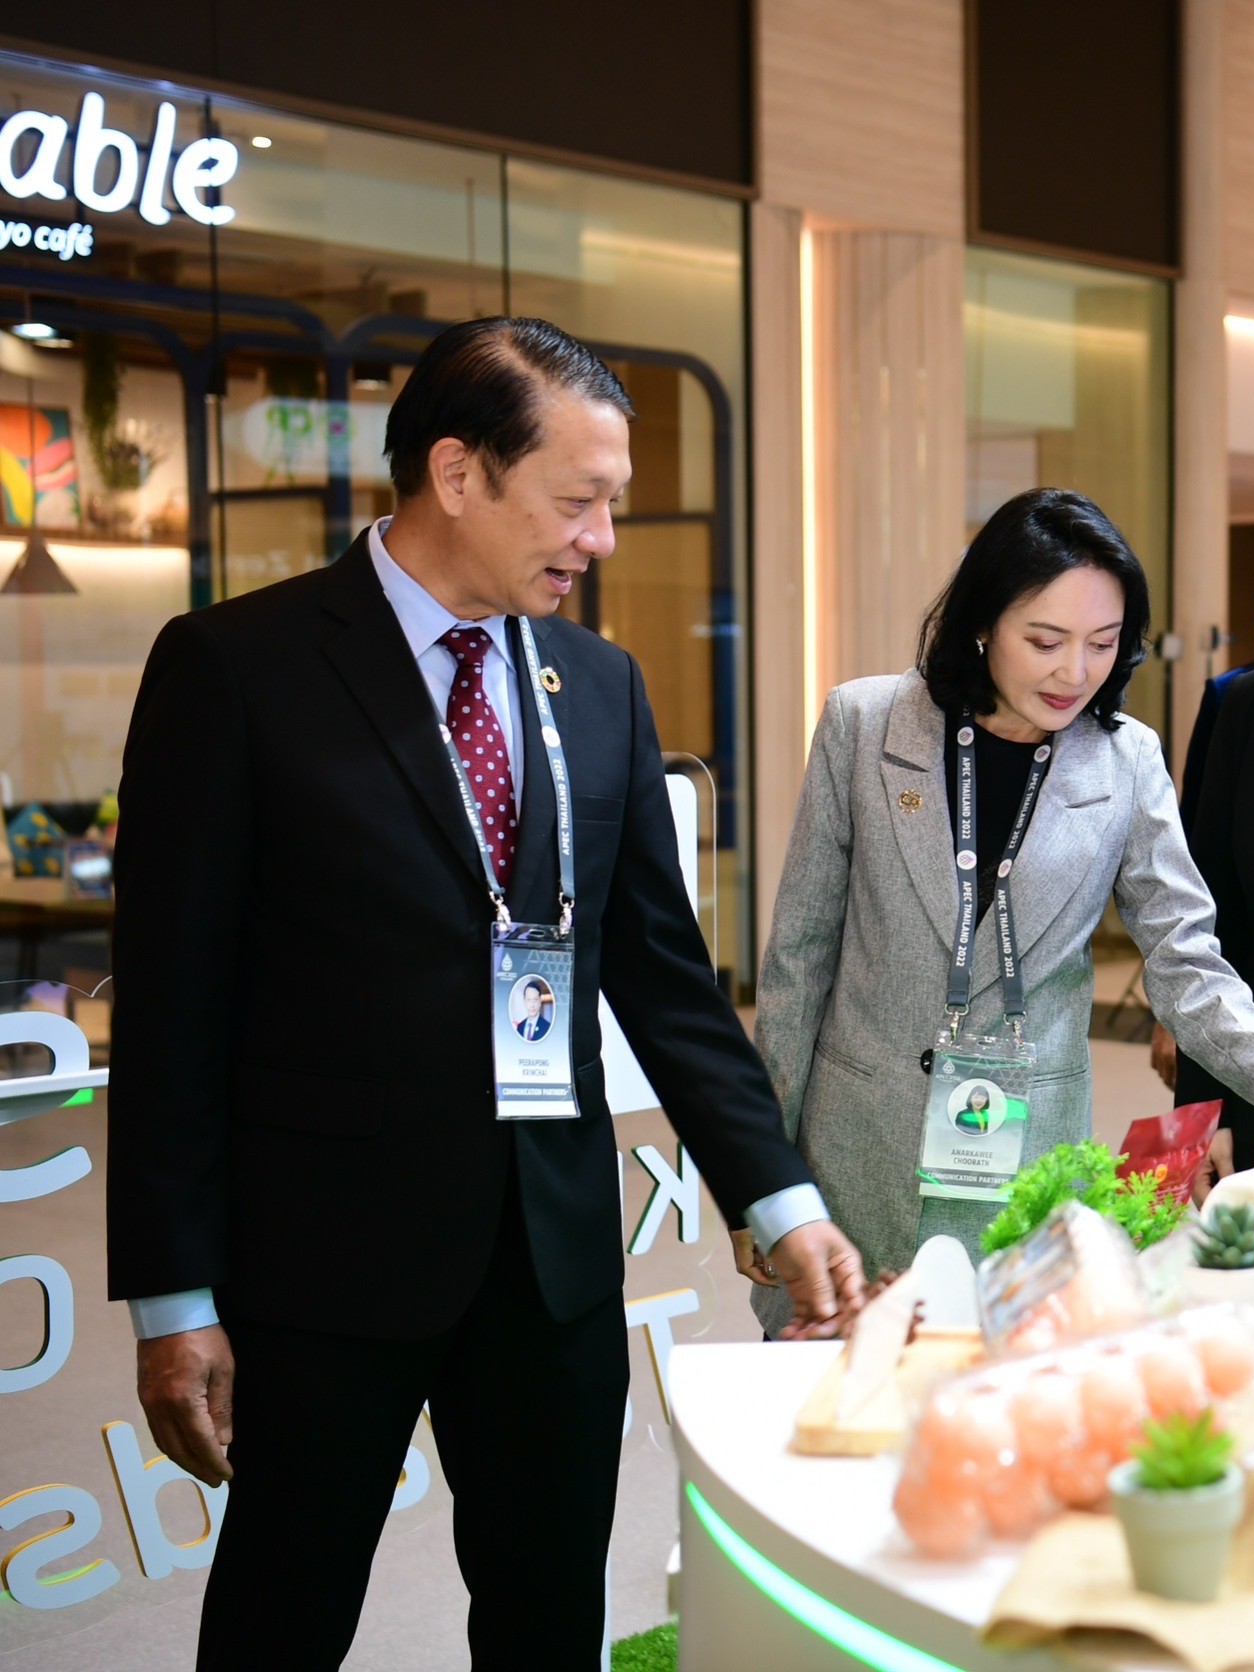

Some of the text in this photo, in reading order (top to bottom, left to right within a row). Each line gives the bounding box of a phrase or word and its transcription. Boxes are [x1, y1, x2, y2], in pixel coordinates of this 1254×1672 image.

[0, 92, 239, 226] able
[33, 222, 94, 261] café
[537, 691, 548, 715] APEC
[552, 758, 570, 856] APEC THAILAND 2022
[961, 756, 971, 840] APEC THAILAND 2022
[1008, 772, 1039, 850] APEC THAILAND 2022
[956, 880, 972, 967] APEC THAILAND 2022
[998, 889, 1014, 978] APEC THAILAND 2022
[926, 1171, 1008, 1184] COMMUNICATION PARTNERS
